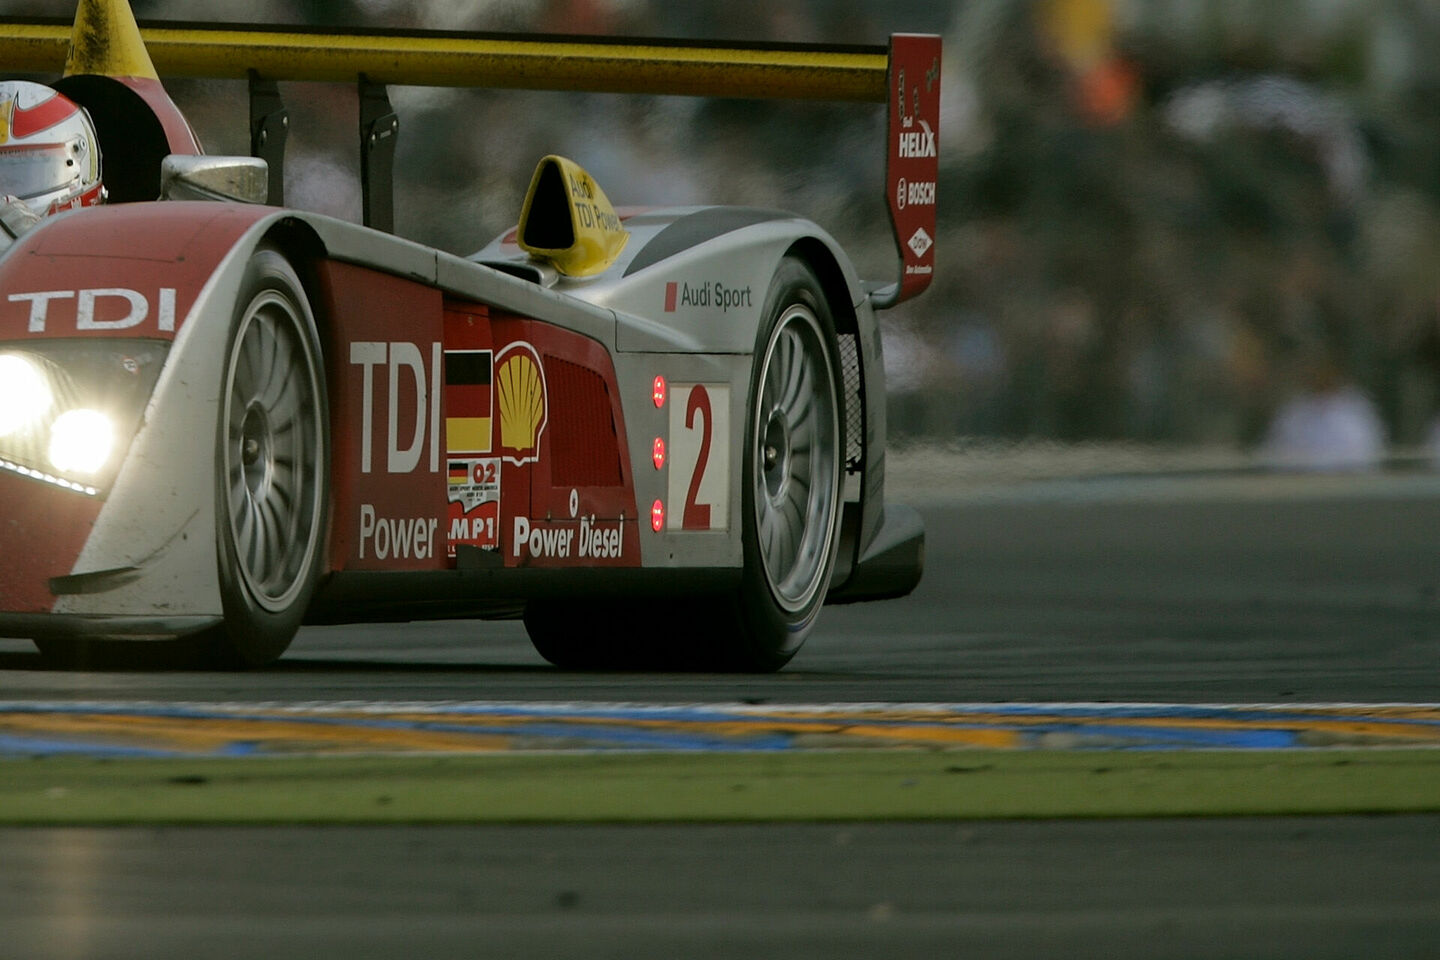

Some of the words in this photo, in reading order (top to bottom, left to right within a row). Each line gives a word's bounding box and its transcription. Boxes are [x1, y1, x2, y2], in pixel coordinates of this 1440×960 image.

[899, 129, 937, 157] HELIX
[569, 174, 594, 199] Audi
[908, 182, 936, 205] BOSCH
[575, 202, 595, 228] TDI
[8, 288, 177, 333] TDI
[681, 282, 711, 307] Audi
[714, 284, 752, 313] Sport
[350, 341, 442, 473] TDI
[682, 384, 712, 530] 2
[473, 463, 496, 484] 02
[360, 503, 438, 560] Power
[448, 517, 494, 540] MP1
[513, 516, 574, 558] Power
[578, 513, 624, 558] Diesel
